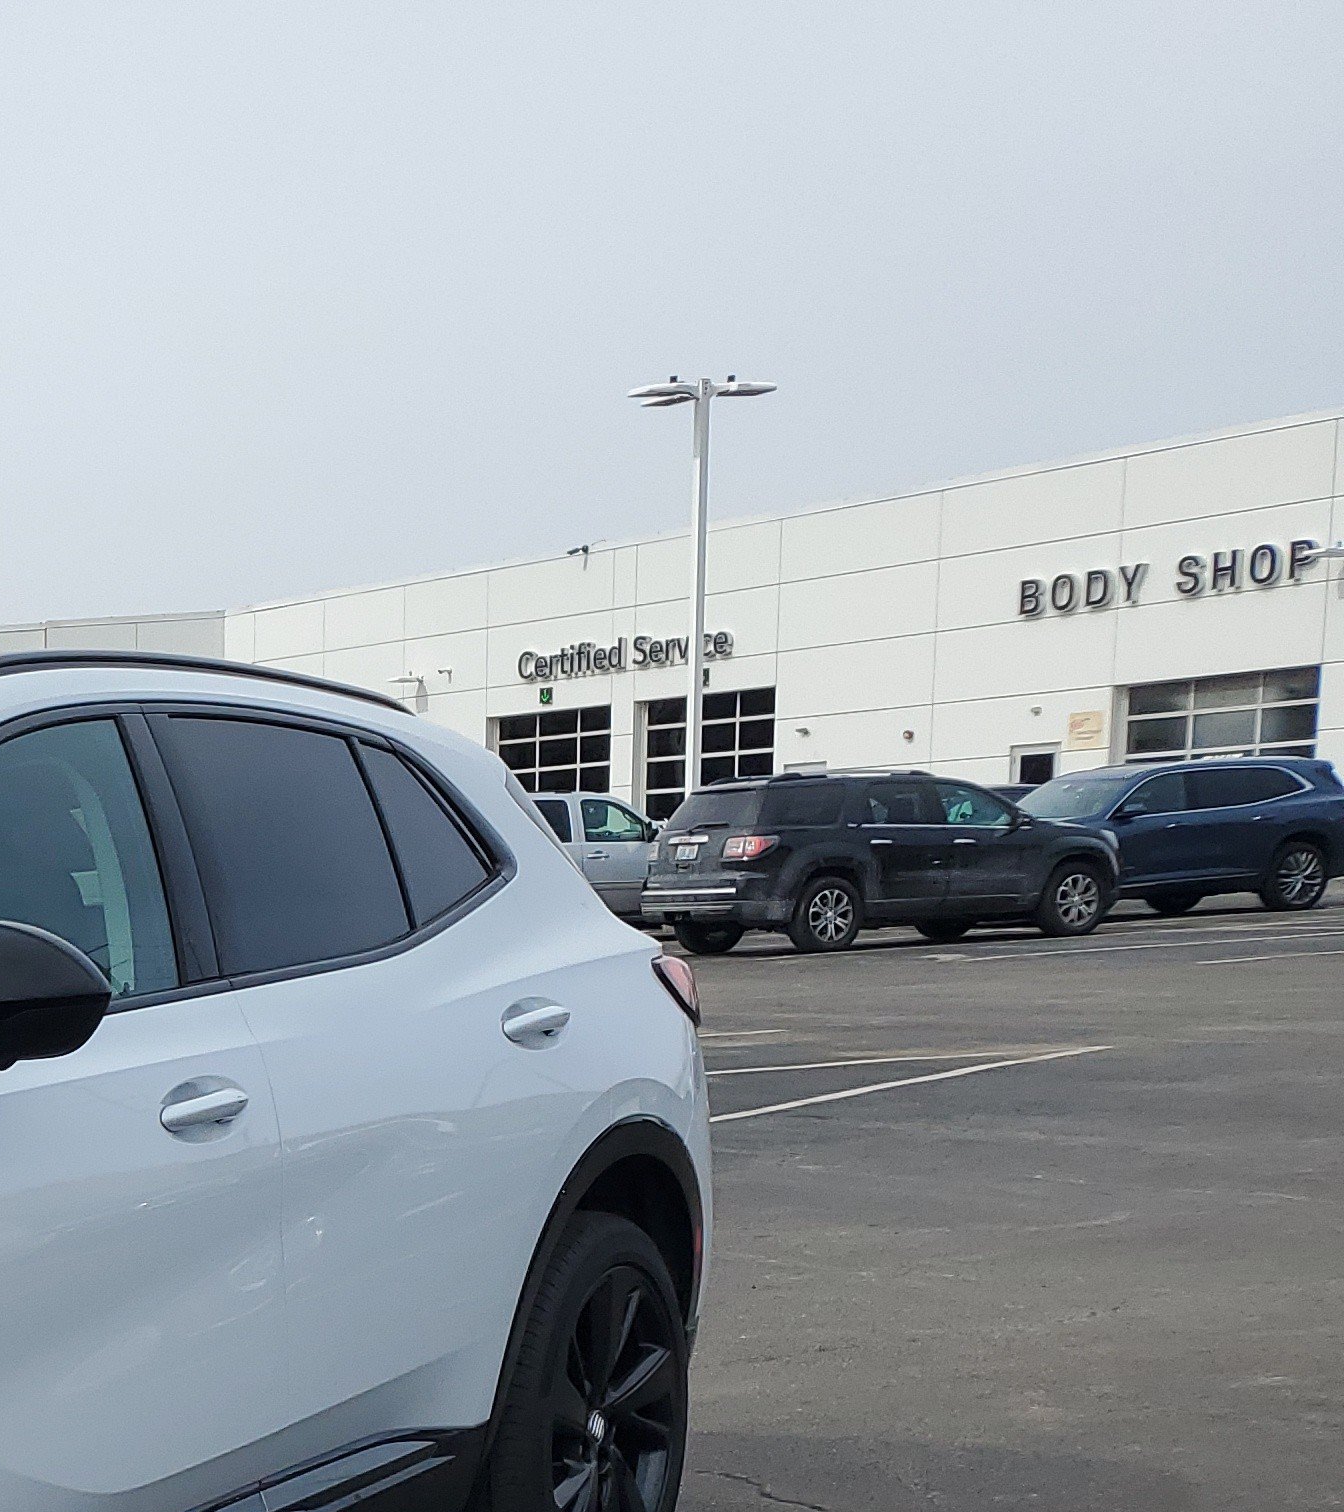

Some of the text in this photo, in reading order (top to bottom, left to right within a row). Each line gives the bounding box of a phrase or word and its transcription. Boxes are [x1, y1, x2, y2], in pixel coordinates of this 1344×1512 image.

[1018, 539, 1319, 618] BODY SHOP
[517, 630, 734, 681] Certified Servce
